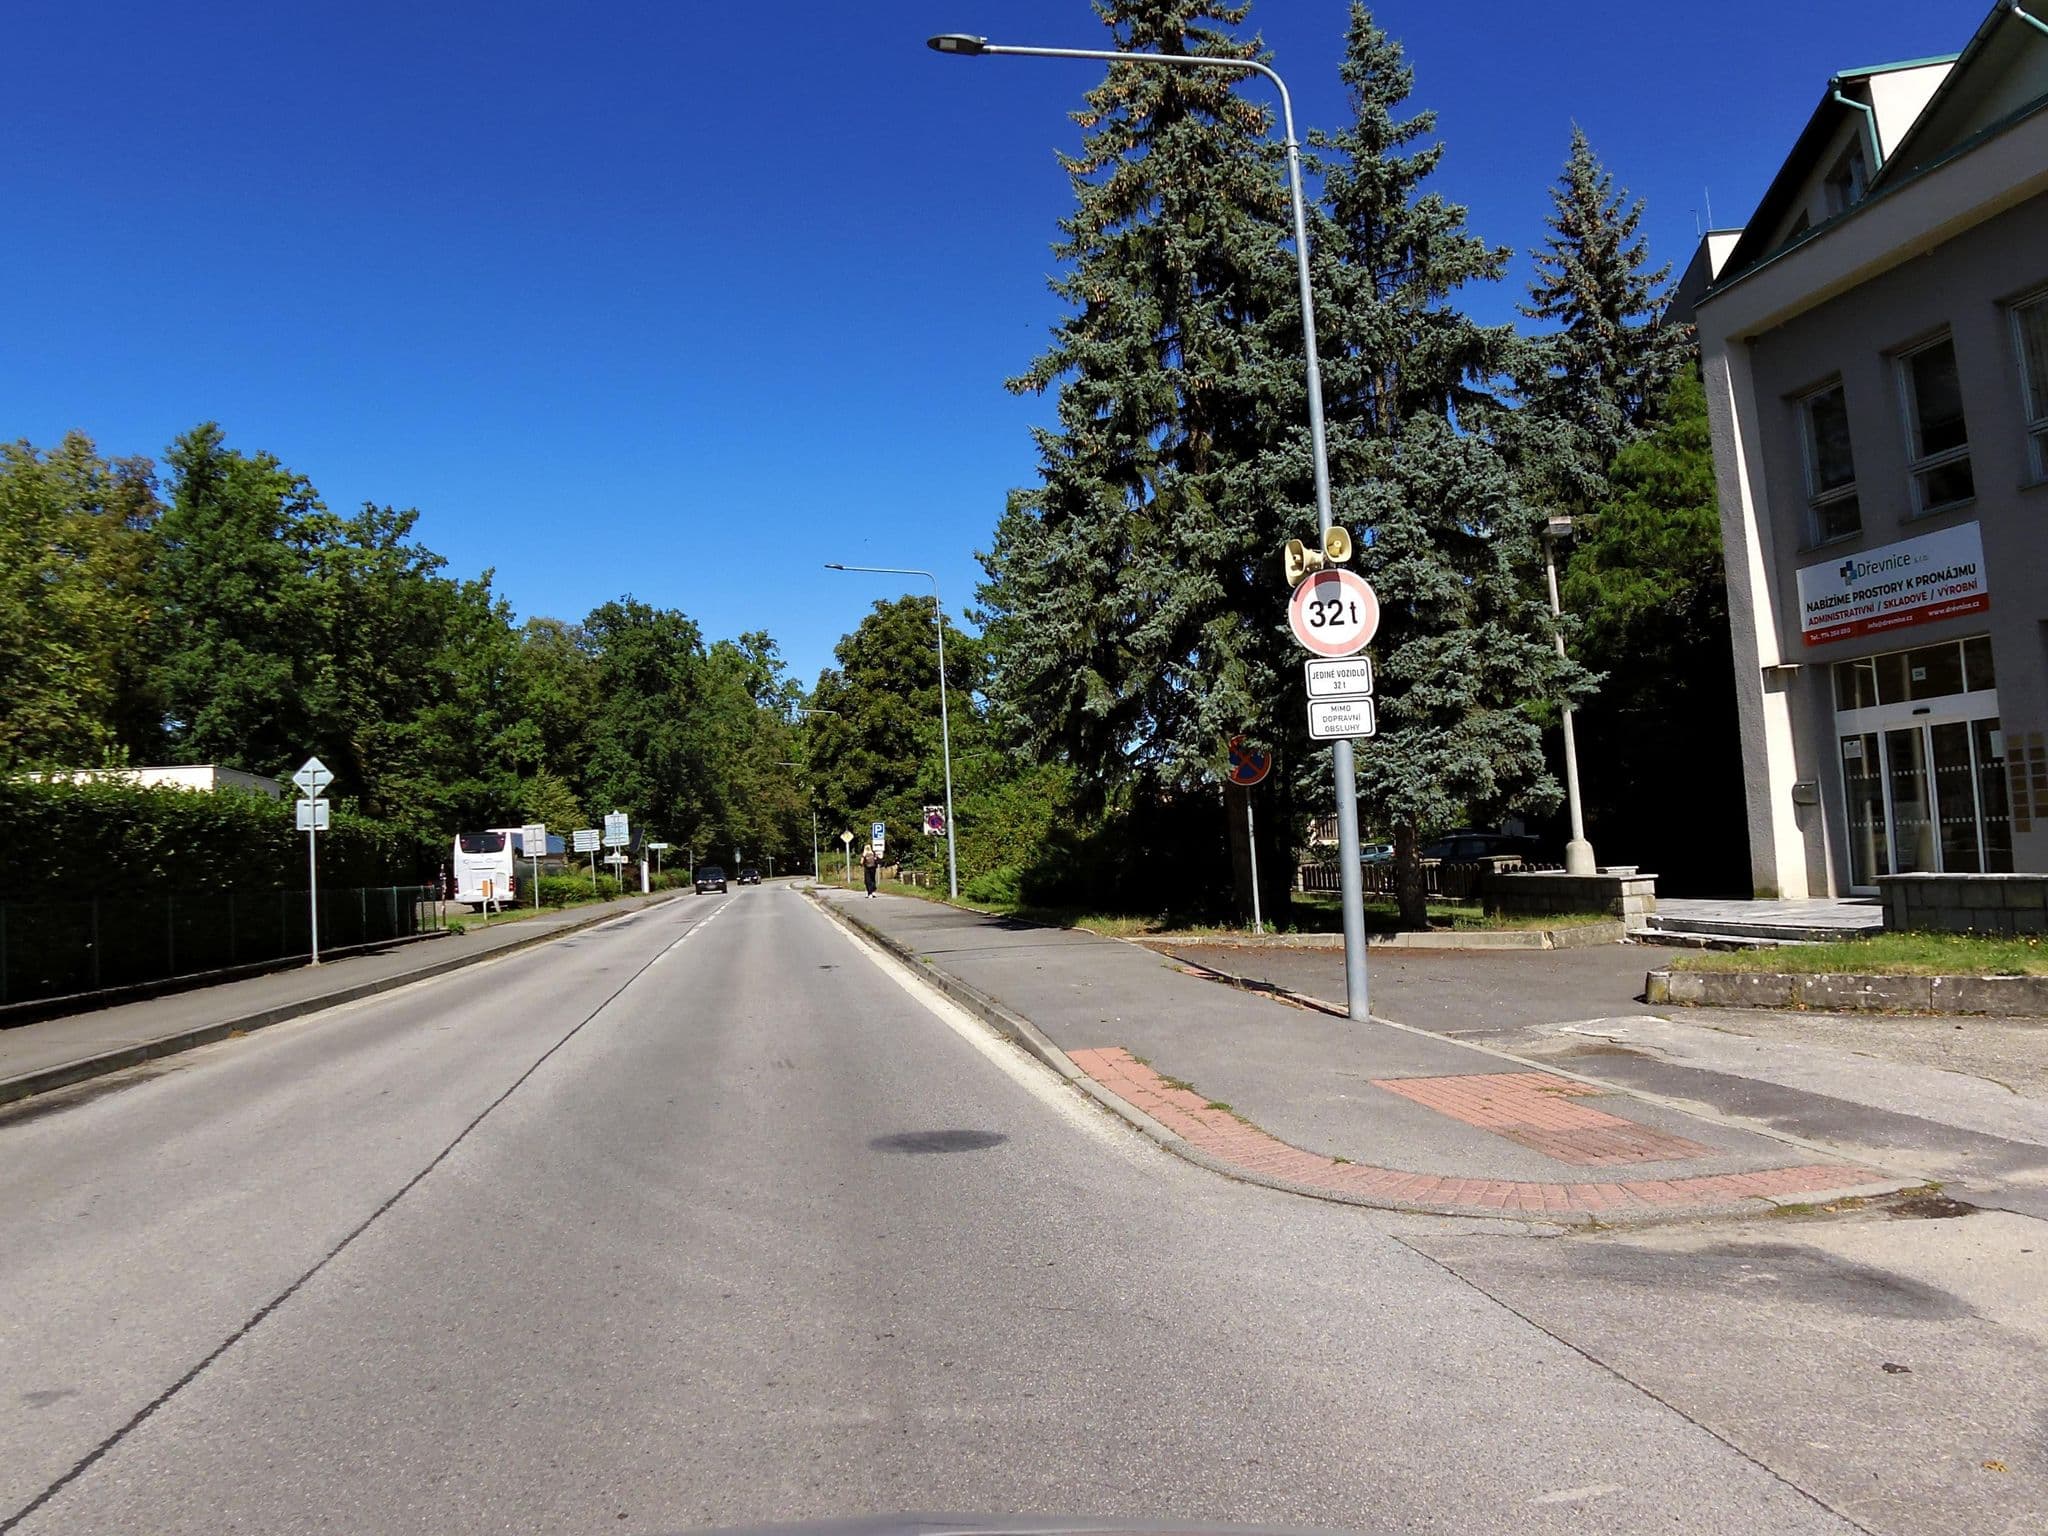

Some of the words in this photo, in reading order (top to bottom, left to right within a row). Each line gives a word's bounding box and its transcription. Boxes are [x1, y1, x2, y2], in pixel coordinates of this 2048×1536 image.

[1857, 553, 1911, 578] Dřevnice
[1806, 593, 1852, 613] NABÍZÍME
[1853, 580, 1903, 602] PROSTORY
[1906, 577, 1914, 590] K
[1916, 562, 1976, 588] PRONÁJMU
[1937, 578, 1978, 598] VÝROBNÍ
[1309, 599, 1345, 628] 32
[1350, 600, 1358, 624] t
[1312, 670, 1335, 680] JEDINÉ
[1336, 668, 1365, 678] VOZIDLO
[1322, 714, 1361, 722] DOPRAVNÍ
